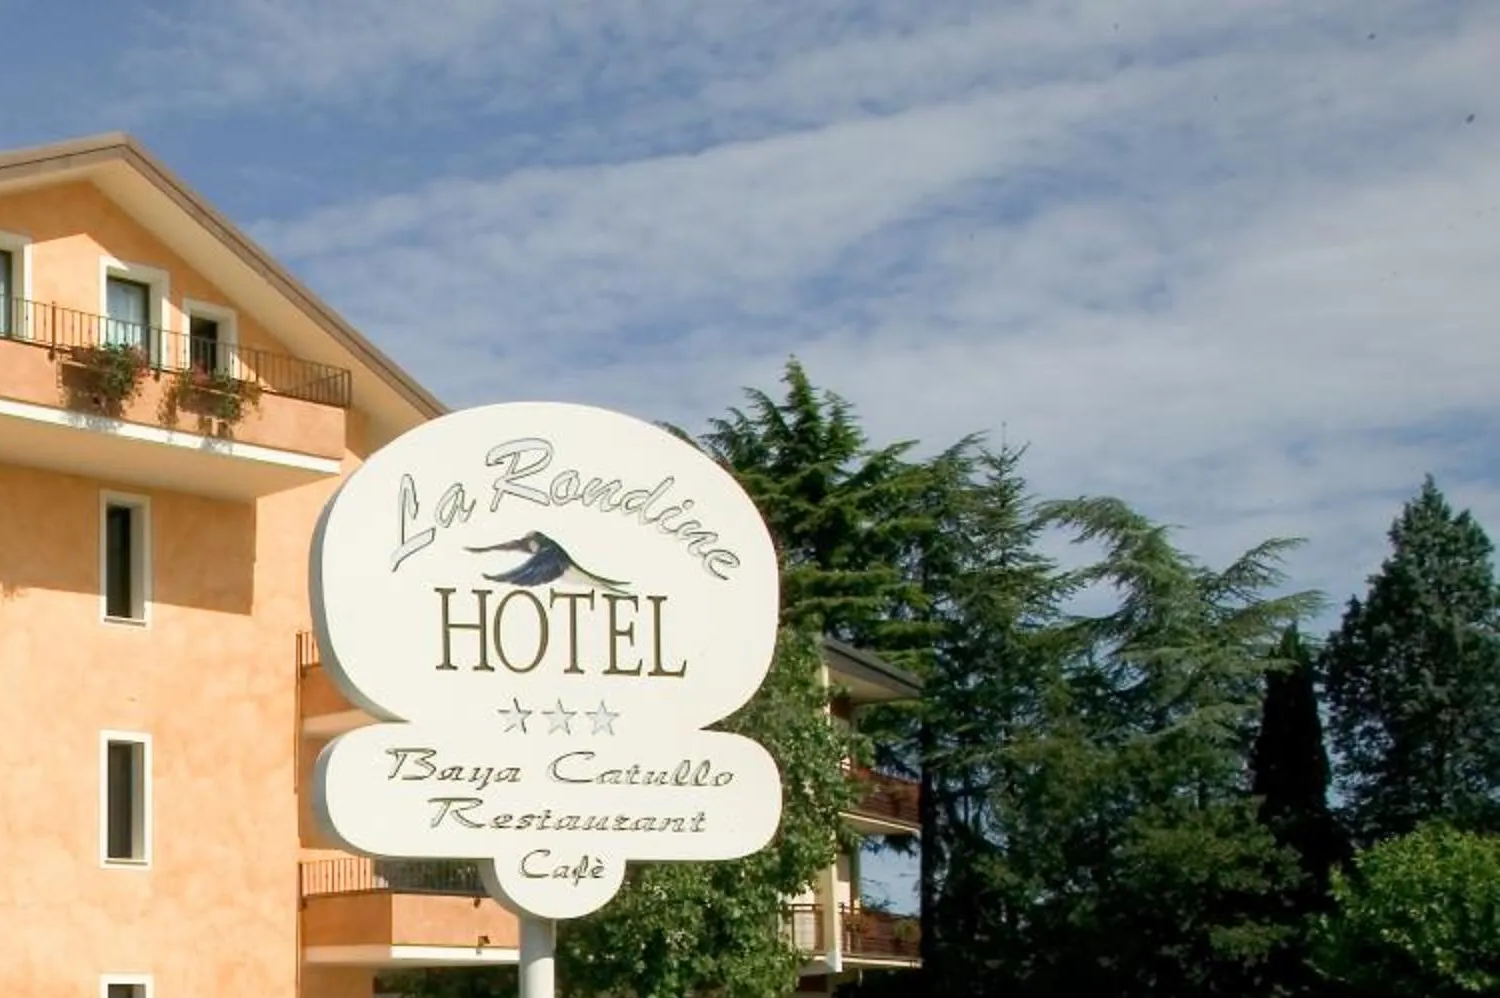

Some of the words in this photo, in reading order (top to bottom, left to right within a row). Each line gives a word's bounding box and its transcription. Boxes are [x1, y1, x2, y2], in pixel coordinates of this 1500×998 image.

[392, 473, 476, 572] La
[485, 437, 740, 580] Rondine
[435, 588, 687, 677] HOTEL
[386, 748, 522, 790] Baya
[548, 750, 735, 788] Catullo
[427, 797, 707, 833] Restaurant
[521, 849, 605, 887] Cafè
